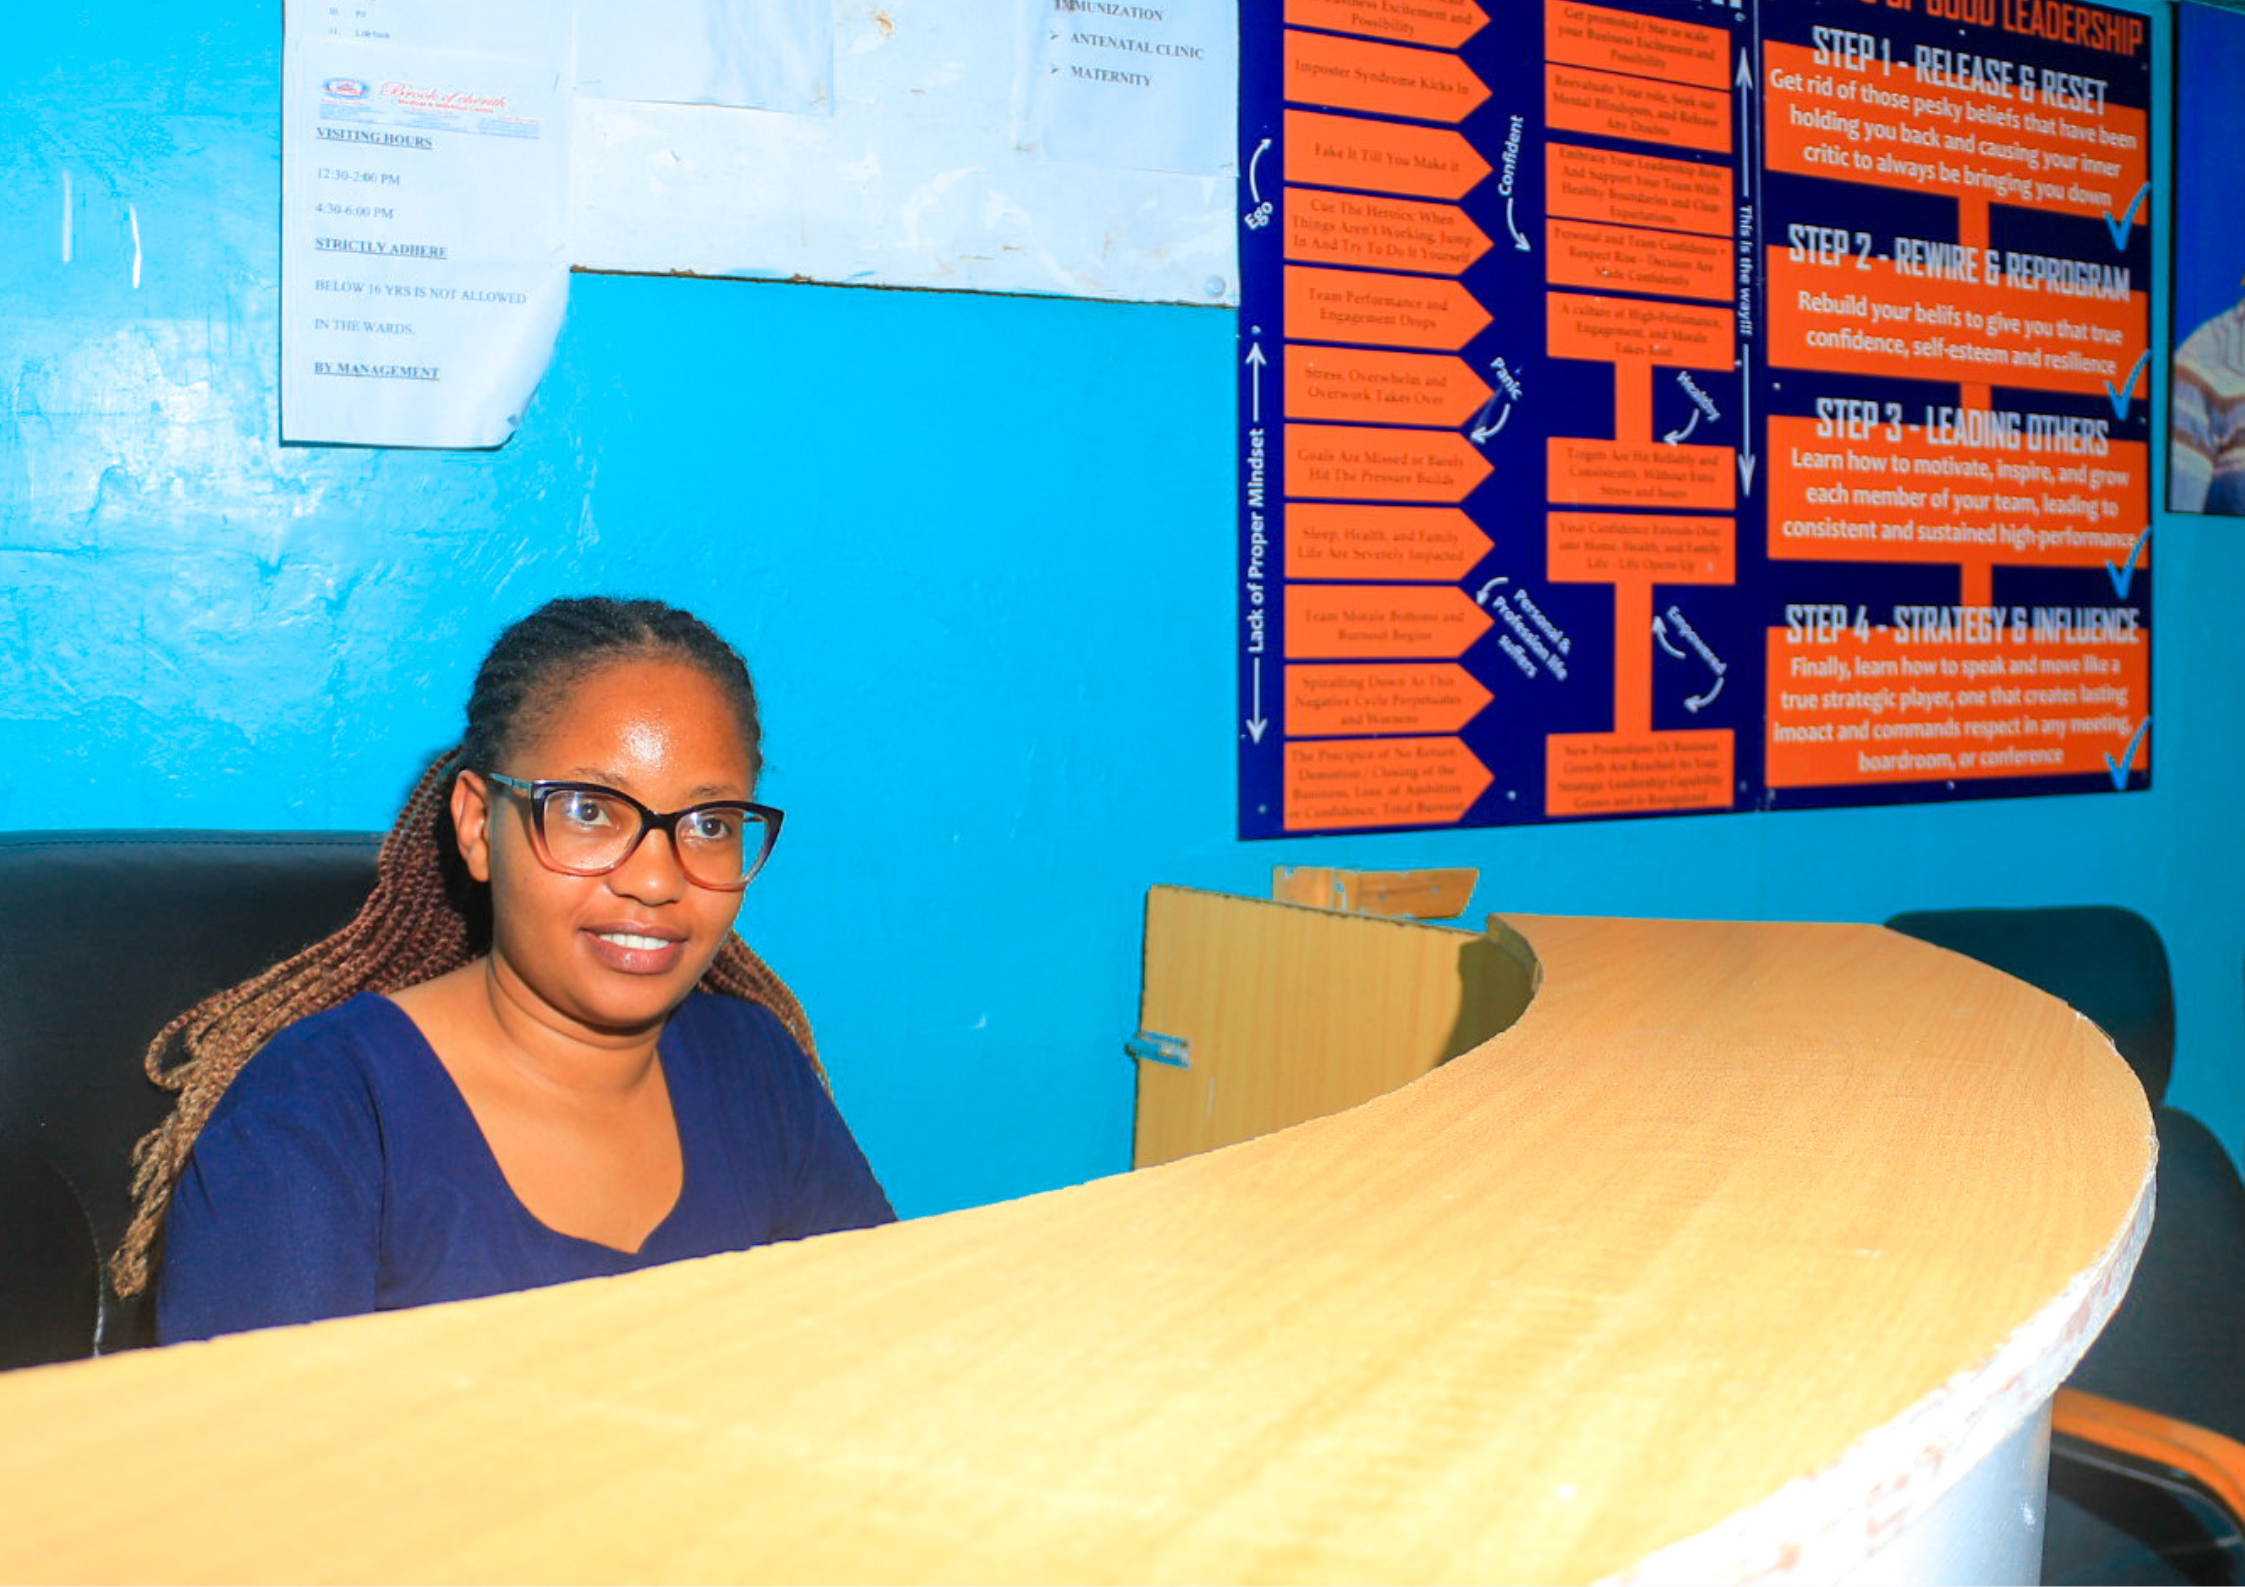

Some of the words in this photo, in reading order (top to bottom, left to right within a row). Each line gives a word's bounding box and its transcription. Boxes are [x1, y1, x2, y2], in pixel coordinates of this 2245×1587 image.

[1054, 0, 1162, 21] IMMUNIZATION
[2002, 0, 2142, 56] LEADERSHIP
[1072, 33, 1153, 53] ANTENATAL
[1156, 44, 1204, 58] CLINIC
[1071, 66, 1152, 86] MATERNITY
[1296, 59, 1350, 79] Imposter
[1354, 66, 1416, 87] Syndrome
[1420, 76, 1453, 93] Kicks
[1457, 82, 1470, 95] In
[1812, 25, 1875, 76] STEP
[1881, 37, 1892, 76] 1
[1915, 44, 2013, 99] RELEASE
[2019, 65, 2036, 104] &
[2041, 69, 2108, 116] RESET
[1770, 68, 1803, 91] Get
[1807, 73, 1833, 97] rid
[1838, 79, 1858, 100] of
[1861, 83, 1909, 110] those
[1913, 92, 1962, 123] pesky
[1966, 97, 2020, 129] beliefs
[2024, 107, 2056, 136] that
[2059, 112, 2096, 144] have
[2099, 120, 2137, 150] been
[317, 127, 380, 144] VISITING
[384, 132, 432, 148] HOURS
[1498, 114, 1524, 195] Confident
[1790, 104, 1860, 140] holding
[1863, 121, 1895, 144] you
[1900, 120, 1939, 150] back
[1944, 128, 1975, 154] and
[1979, 138, 2039, 170] causing
[2043, 151, 2079, 175] your
[2081, 153, 2122, 178] inner
[318, 167, 378, 184] 12:30-2:00
[381, 174, 400, 186] PM
[1804, 144, 1849, 167] critic
[1853, 151, 1872, 170] to
[1876, 154, 1936, 185] always
[1939, 162, 1960, 185] be
[1963, 167, 2032, 200] bringing
[2034, 181, 2066, 202] you
[2068, 182, 2113, 207] down
[316, 203, 371, 217] 4:30-6:00
[374, 206, 394, 219] PM
[1244, 202, 1273, 230] Ego
[315, 237, 386, 254] STRICTLY
[390, 244, 447, 258] ADHERE
[1788, 223, 1849, 266] STEP
[1856, 232, 1872, 271] 2
[1895, 236, 1978, 284] REWIRE
[1985, 248, 2000, 287] &
[2007, 253, 2131, 302] REPROGRAM
[315, 280, 364, 293] BELOW
[368, 284, 381, 294] 16
[385, 285, 411, 297] YRS
[414, 287, 426, 297] IS
[430, 288, 457, 299] NOT
[461, 290, 527, 304] ALLOWED
[315, 319, 329, 329] IN
[334, 320, 360, 331] THE
[363, 322, 415, 335] WARDS.
[1798, 290, 1867, 318] Rebuild
[1871, 300, 1911, 324] your
[1915, 302, 1961, 328] belifs
[1965, 309, 1983, 329] to
[1986, 313, 2021, 338] give
[2024, 321, 2054, 340] you
[2057, 318, 2088, 340] that
[2091, 324, 2123, 344] true
[315, 362, 333, 373] BY
[337, 362, 439, 378] MANAGEMENT
[1806, 327, 1909, 359] confidence,
[1914, 338, 2008, 363] self-esteem
[2012, 347, 2041, 367] and
[2045, 351, 2117, 375] resilience
[1490, 356, 1522, 400] Panic
[1677, 370, 1721, 422] Healthy
[1816, 397, 1879, 440] STEP
[1885, 403, 1902, 442] 3
[1926, 405, 2021, 450] LEADING
[2027, 415, 2110, 456] OTHERS
[1247, 428, 1265, 507] Mindset
[1792, 447, 1843, 470] Learn
[1847, 450, 1886, 472] how
[1891, 455, 1910, 474] to
[1915, 456, 1993, 481] motivate,
[1997, 460, 2055, 486] inspire,
[2058, 466, 2087, 485] and
[2089, 469, 2129, 489] grow
[1806, 484, 1848, 504] each
[1852, 486, 1926, 507] member
[1930, 488, 1949, 508] of
[1952, 493, 1991, 514] your
[1994, 494, 2040, 516] team,
[2043, 496, 2098, 522] leading
[2102, 501, 2119, 518] to
[1248, 512, 1267, 579] Proper
[1783, 518, 1876, 539] consistent
[1881, 520, 1913, 540] and
[1918, 521, 1997, 544] sustained
[1247, 583, 1265, 605] of
[1247, 609, 1265, 653] Lack
[1513, 588, 1563, 644] Personal
[1786, 604, 1847, 644] STEP
[1853, 604, 1869, 644] 4
[1894, 606, 2007, 644] STRATEGY
[2012, 606, 2028, 644] &
[2033, 608, 2140, 644] INFLUENCE
[1492, 595, 1549, 661] Profession
[1546, 653, 1568, 682] life
[1497, 634, 1537, 678] suffers
[1666, 605, 1727, 676] Empowered
[1791, 656, 1852, 681] Finally,
[1855, 657, 1898, 677] learn
[1902, 656, 1937, 676] how
[1941, 659, 1958, 676] to
[1962, 656, 2005, 680] speak
[2010, 656, 2036, 675] and
[2040, 661, 2080, 675] move
[2083, 655, 2110, 674] like
[2112, 660, 2121, 674] a
[1781, 691, 1818, 710] true
[1823, 689, 1895, 713] strategic
[1900, 688, 1954, 711] player,
[1958, 692, 1986, 707] one
[1990, 687, 2021, 705] that
[2025, 687, 2076, 704] creates
[2080, 685, 2128, 707] lasting
[1774, 722, 1834, 742] imoact
[1838, 719, 1868, 740] and
[1872, 716, 1960, 740] commands
[1964, 719, 2021, 741] respect
[2023, 715, 2038, 734] in
[2041, 718, 2066, 738] any
[2071, 713, 2133, 737] meeting,
[1859, 753, 1956, 773] boardroom,
[1959, 755, 1978, 770] or
[1980, 746, 2064, 766] conference
